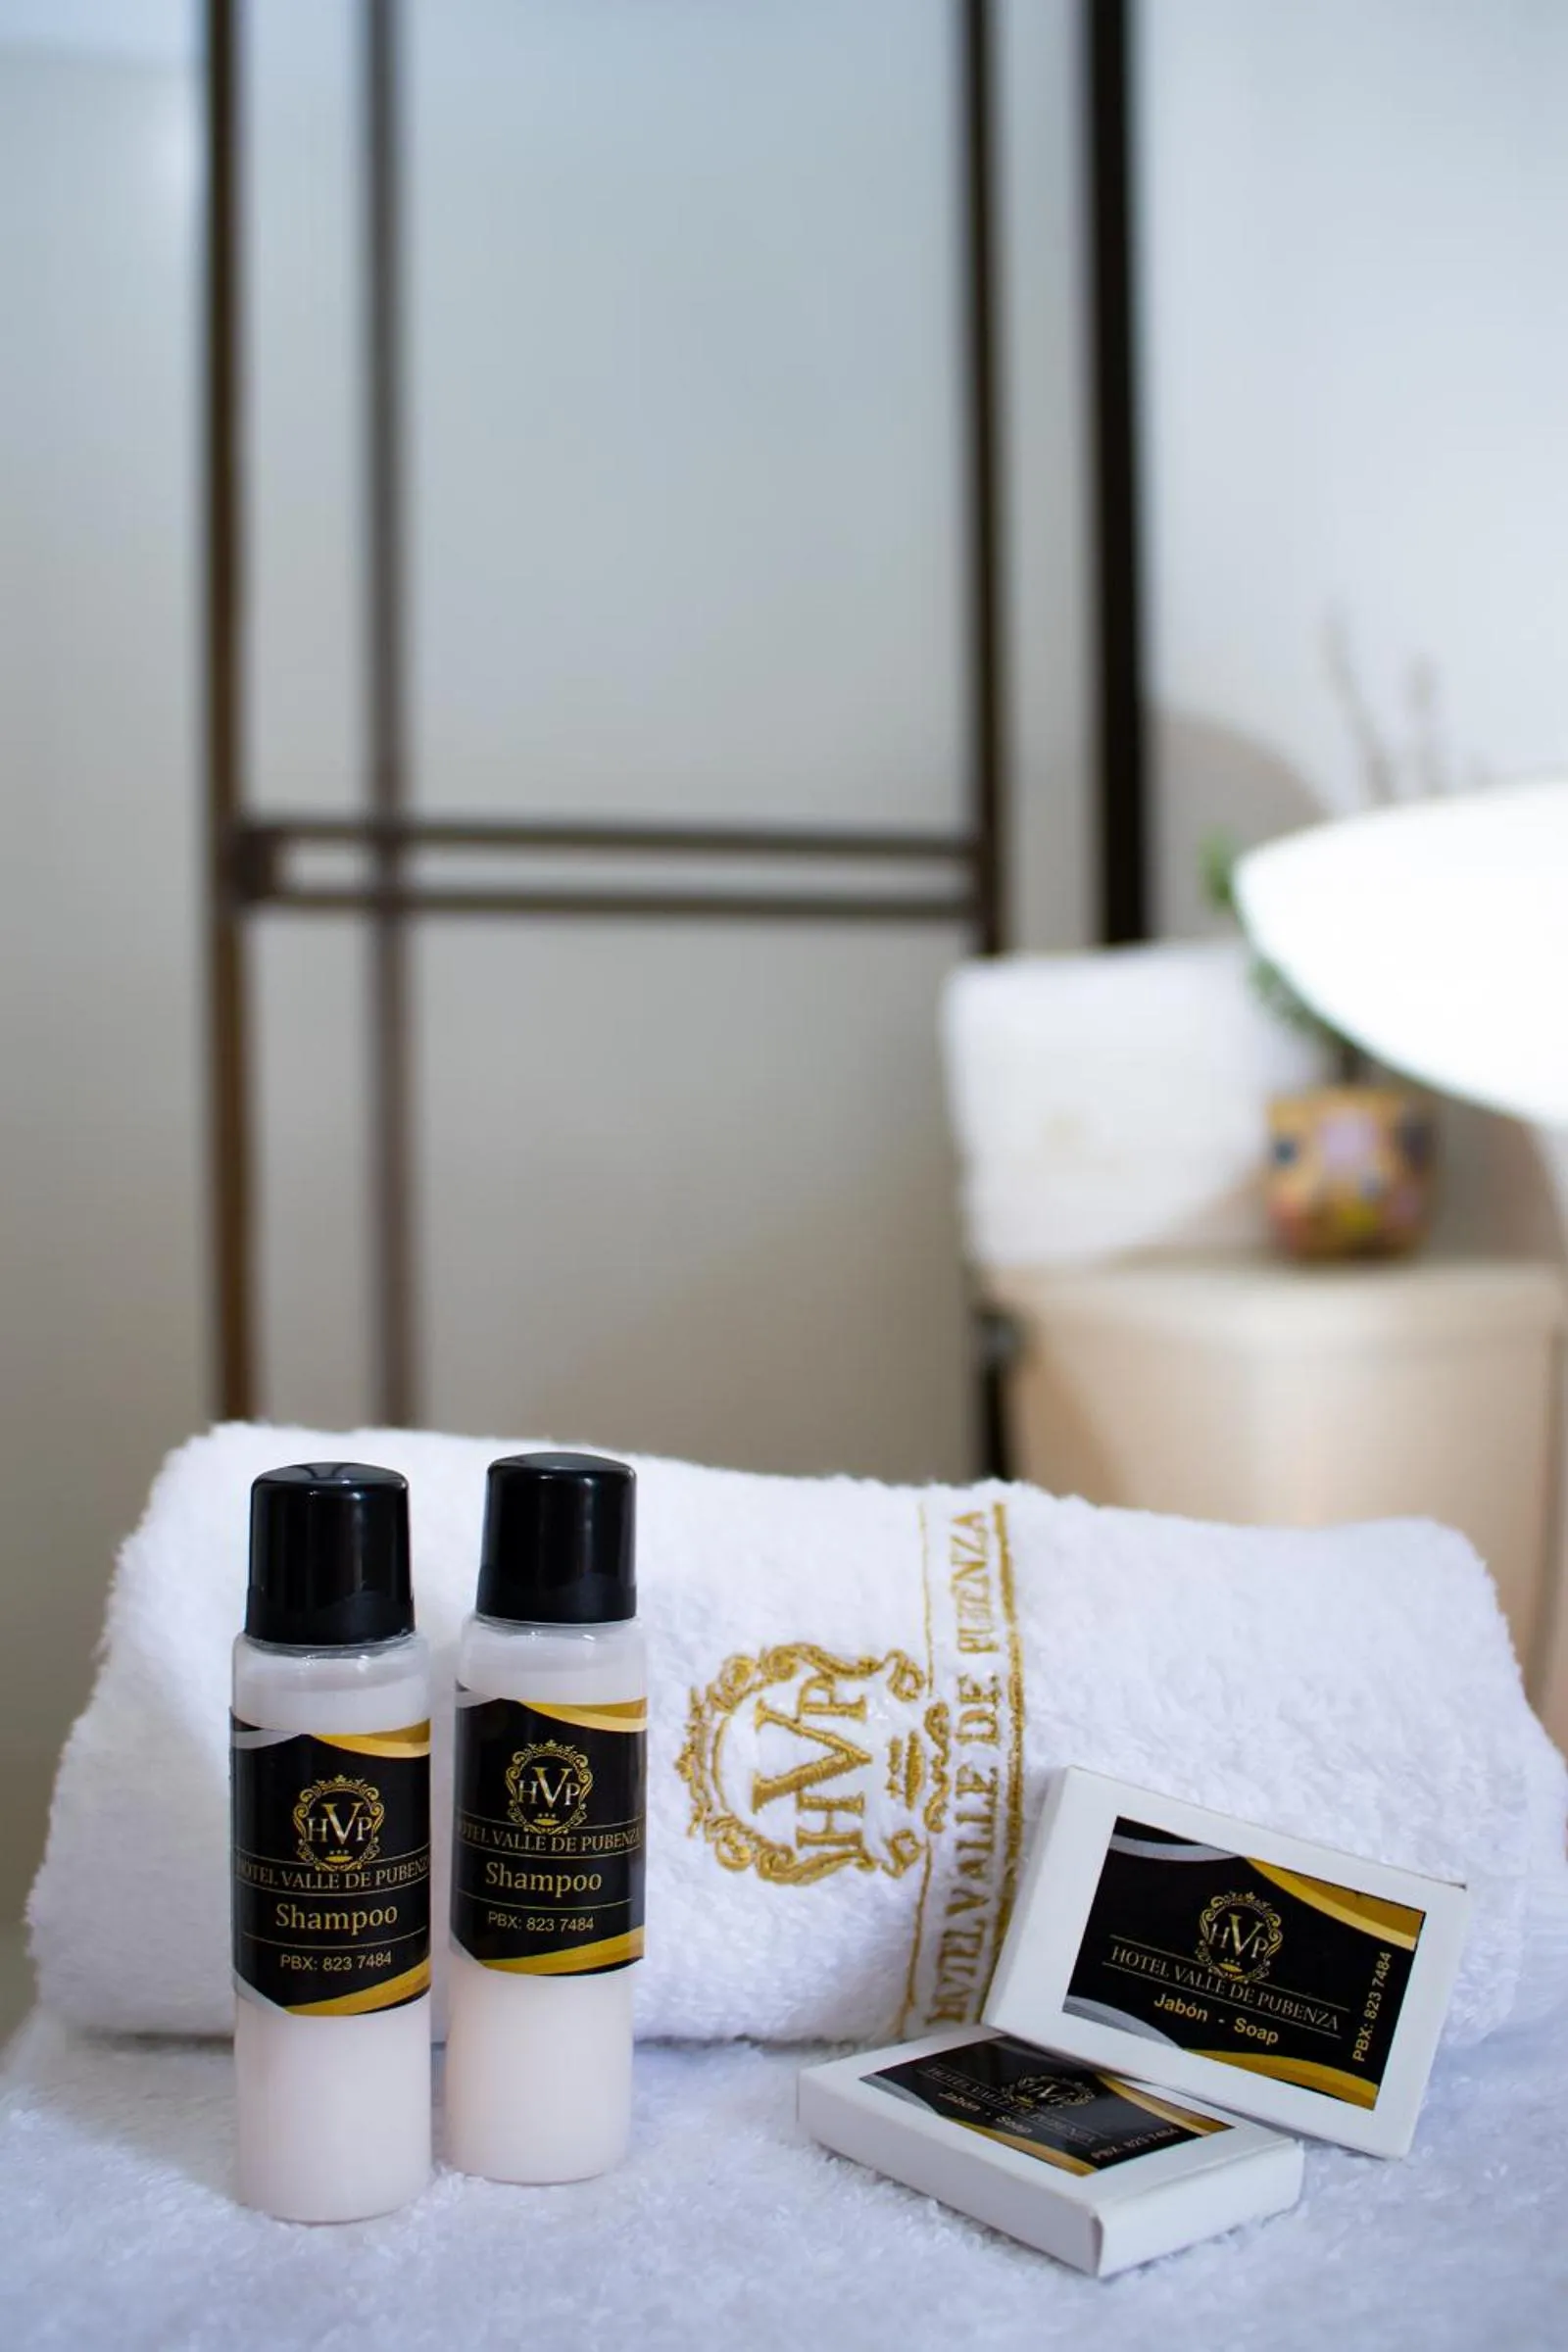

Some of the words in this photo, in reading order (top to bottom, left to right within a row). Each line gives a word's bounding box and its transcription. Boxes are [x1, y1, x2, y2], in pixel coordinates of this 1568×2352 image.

[956, 1673, 1002, 1744] DE
[517, 1766, 581, 1808] HVP
[307, 1802, 372, 1844] HVP
[492, 1829, 546, 1851] VALLE
[551, 1837, 576, 1853] DE
[281, 1870, 340, 1889] VALLE
[345, 1871, 371, 1889] DE
[375, 1854, 429, 1886] PUBENZ
[486, 1861, 603, 1898] Shampoo
[275, 1902, 398, 1936] Shampoo
[488, 1910, 522, 1931] PBX:
[526, 1917, 555, 1933] 823
[560, 1916, 594, 1933] 7484
[280, 1953, 318, 1971] PBX:
[321, 1956, 353, 1972] 823
[357, 1950, 392, 1969] 7484
[1372, 1951, 1393, 1988] 7484
[1111, 1945, 1170, 1979] HOTEL
[1175, 1964, 1227, 1995] VALLE
[1229, 1983, 1255, 2004] DE
[1257, 1991, 1339, 2032] PUBENZA
[1363, 1991, 1383, 2020] 823
[1153, 1992, 1208, 2023] Jabón
[1234, 2017, 1279, 2045] Soap
[1352, 2023, 1374, 2063] PBX:
